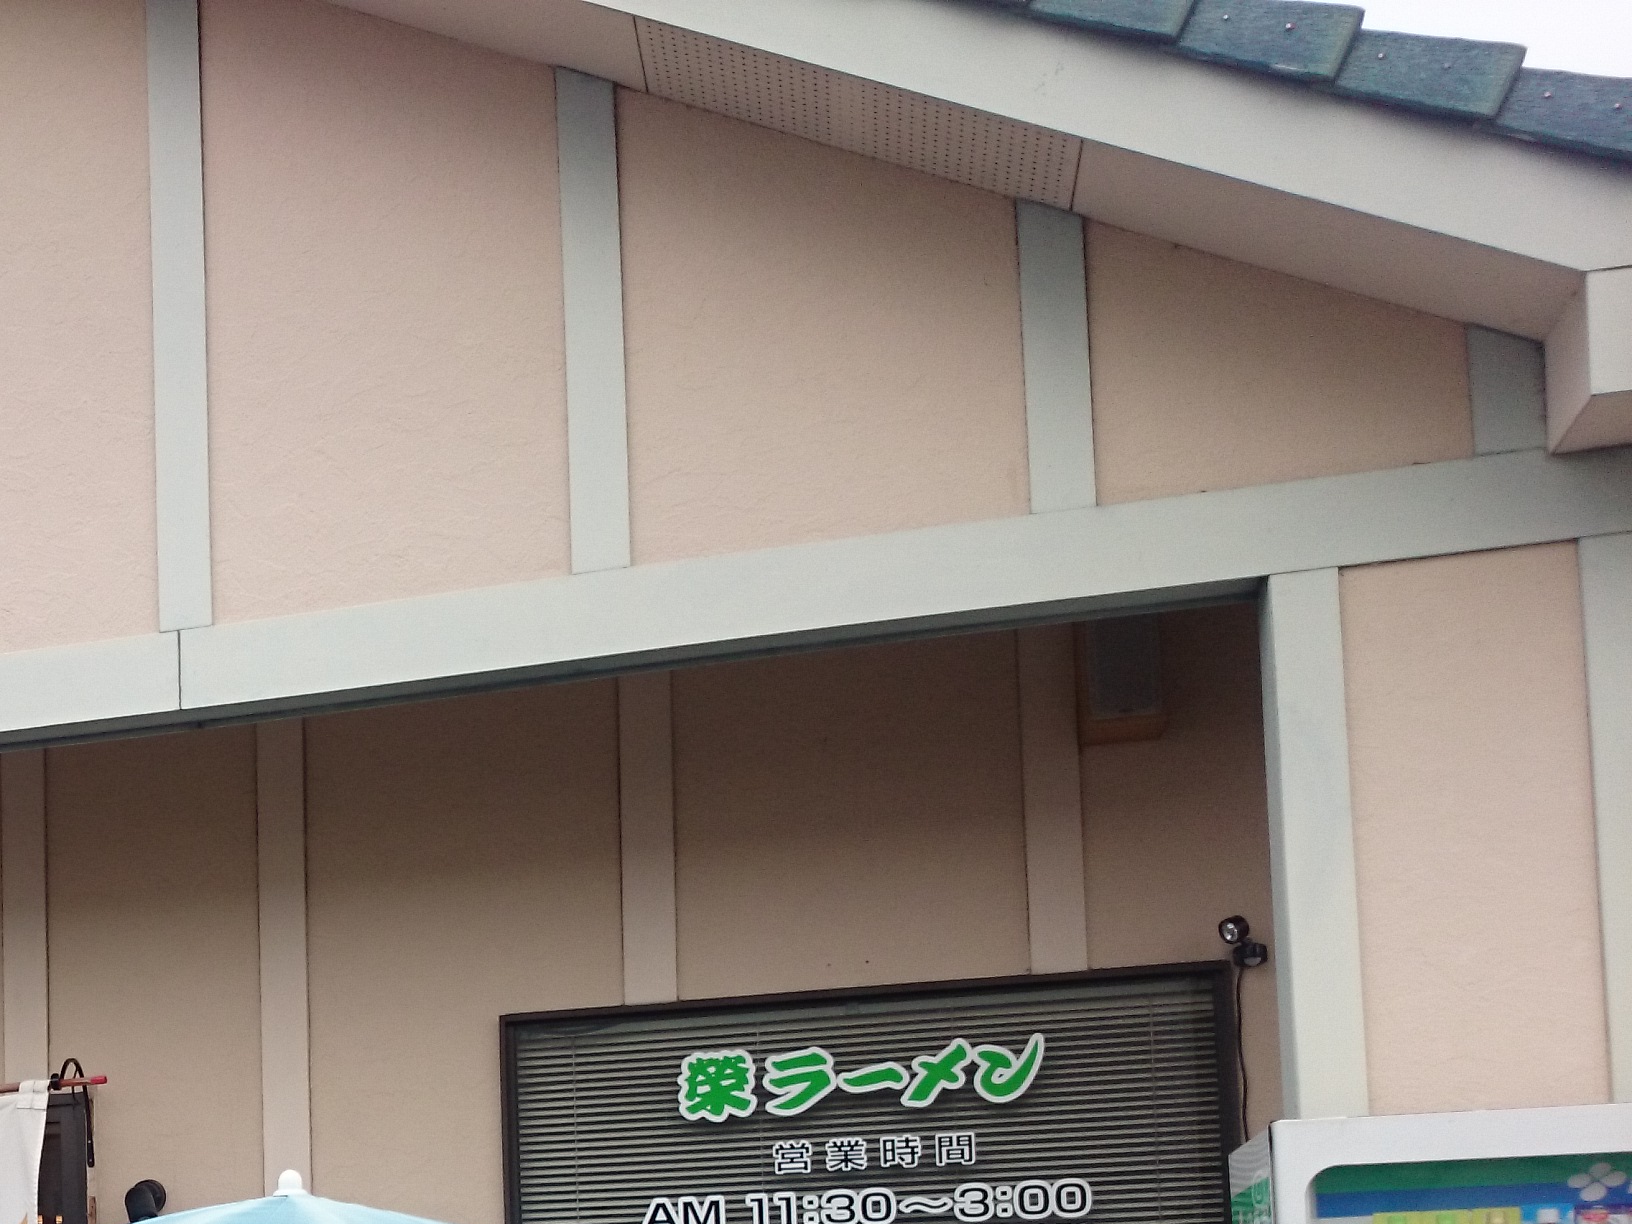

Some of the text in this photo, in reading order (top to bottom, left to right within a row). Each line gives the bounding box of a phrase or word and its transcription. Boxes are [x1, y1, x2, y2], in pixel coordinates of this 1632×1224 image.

[677, 1033, 1045, 1122] 榮ラーメン
[772, 1132, 976, 1174] 営業時間
